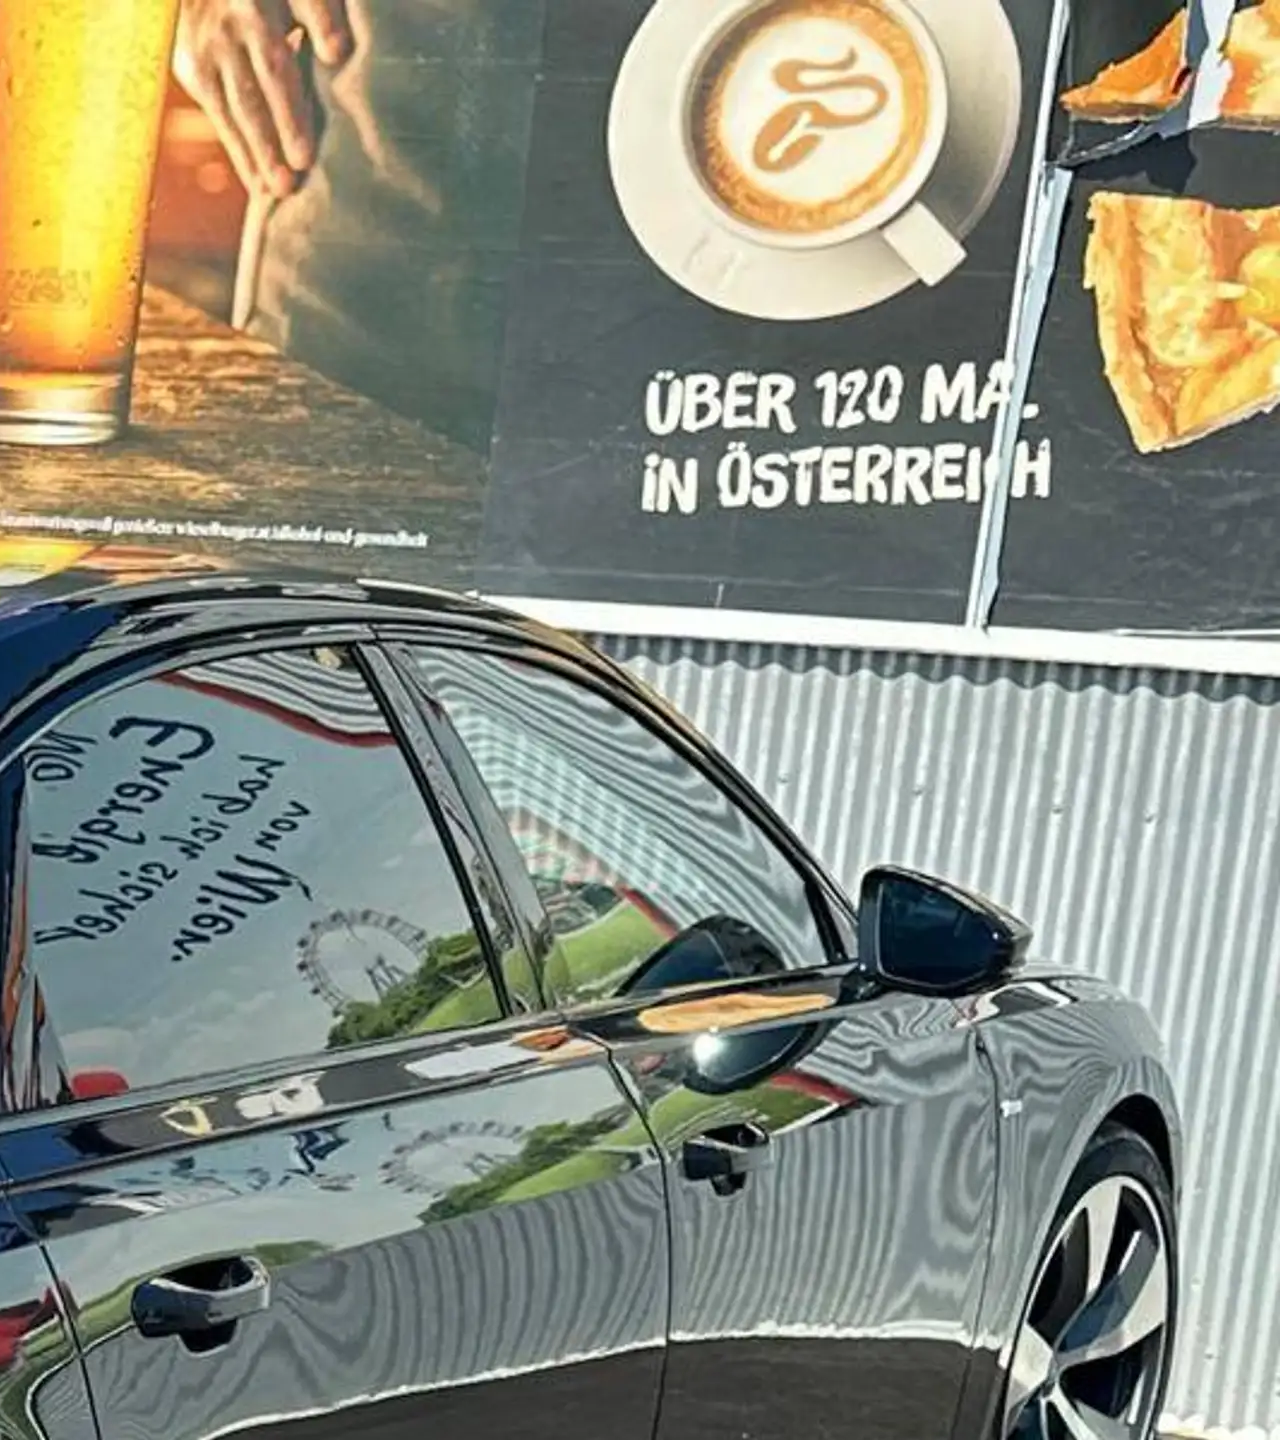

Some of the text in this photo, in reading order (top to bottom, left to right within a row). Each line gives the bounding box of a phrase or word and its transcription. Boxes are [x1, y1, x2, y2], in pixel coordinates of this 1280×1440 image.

[644, 359, 1040, 435] ÜBER 120 MA
